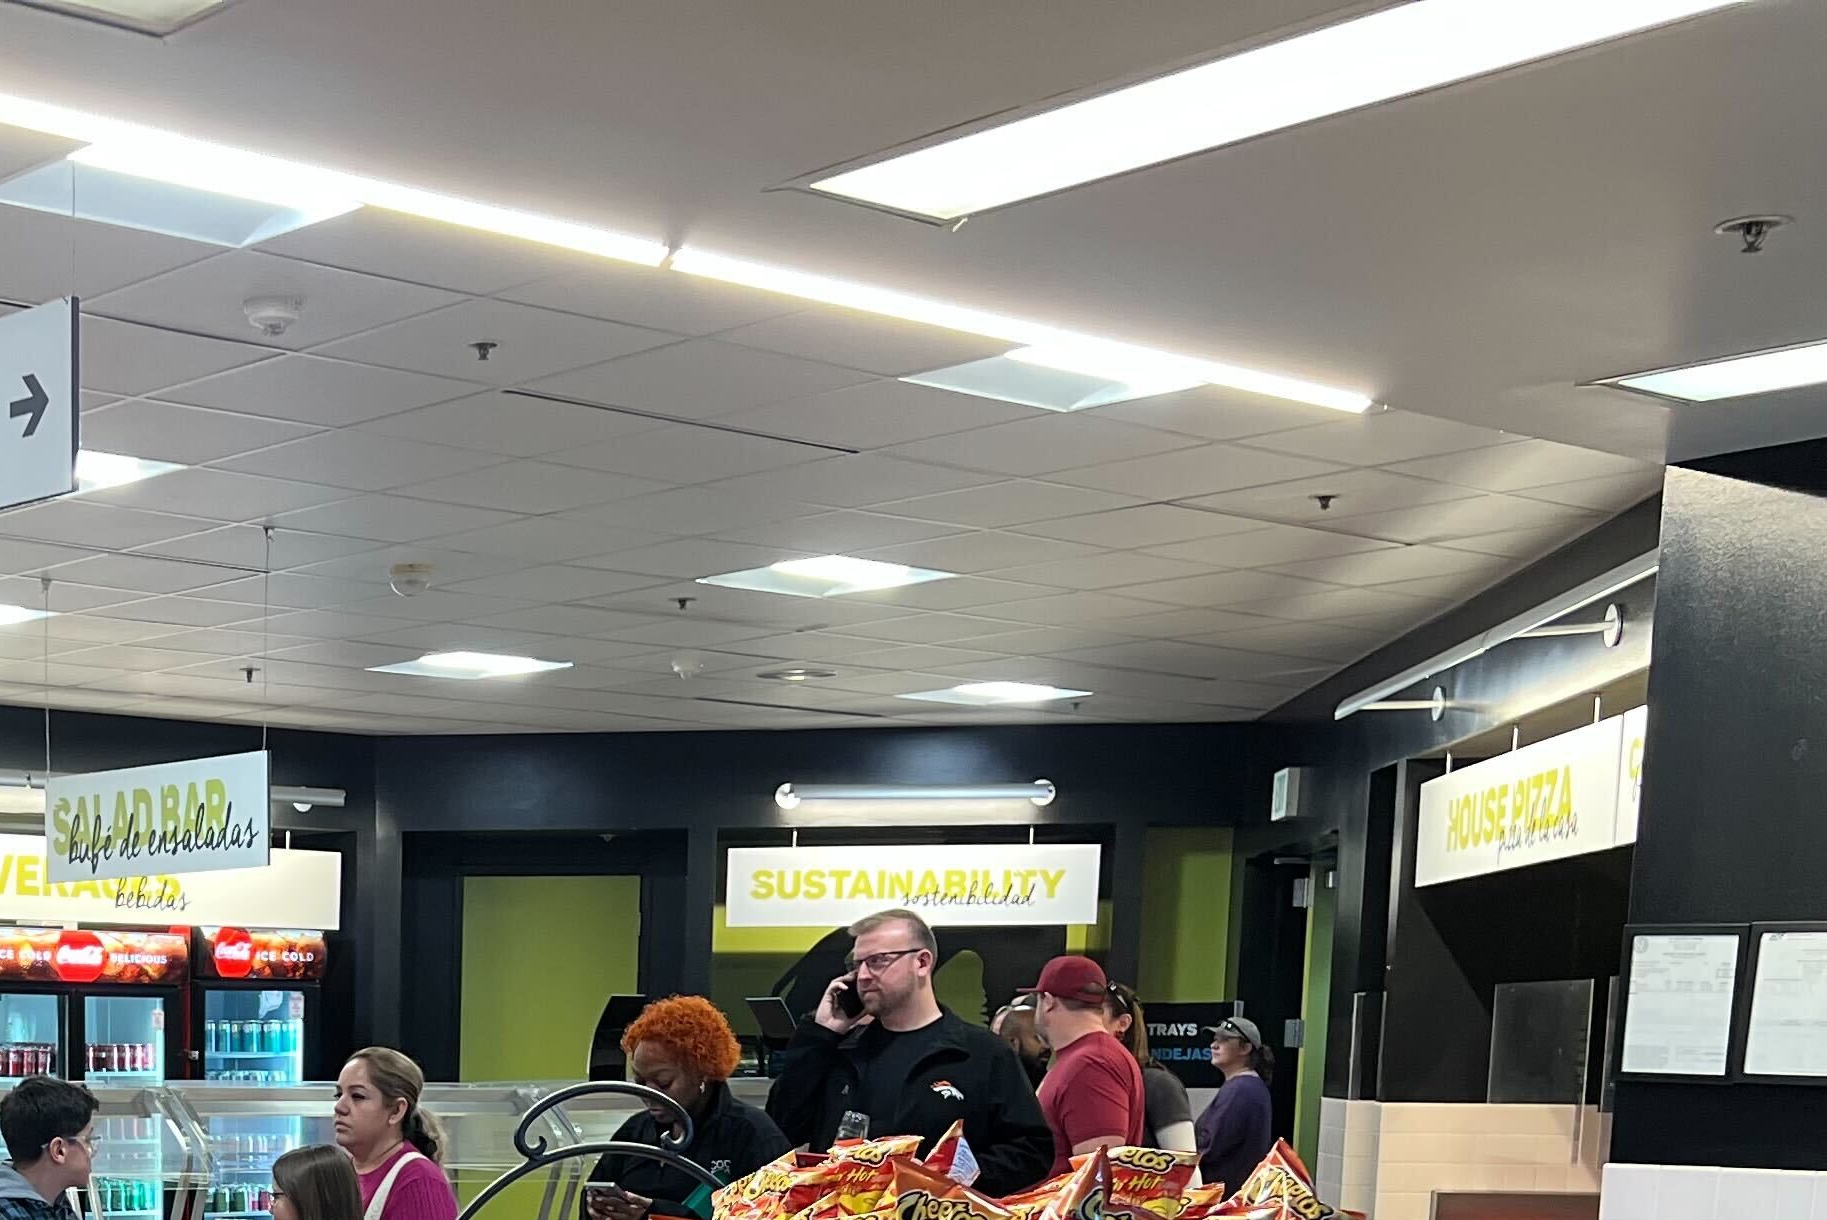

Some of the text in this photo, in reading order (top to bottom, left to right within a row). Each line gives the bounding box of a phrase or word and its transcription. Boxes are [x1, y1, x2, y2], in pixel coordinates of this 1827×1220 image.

[53, 778, 228, 857] SALAD BAR
[1447, 783, 1509, 852] HOUSE
[1512, 765, 1574, 833] PIZZA
[69, 801, 259, 875] bufé de ensaladas
[115, 876, 191, 912] bebidas
[750, 868, 1067, 900] SUSTAINABILITY
[900, 880, 1036, 907] sostenibilidad
[18, 949, 52, 963] COLD
[110, 952, 168, 965] DELICIOUS
[256, 951, 315, 963] ICE COLD
[1147, 1023, 1198, 1037] TRAYS
[1150, 1048, 1213, 1061] NDEJAS
[1129, 1173, 1165, 1191] Hot
